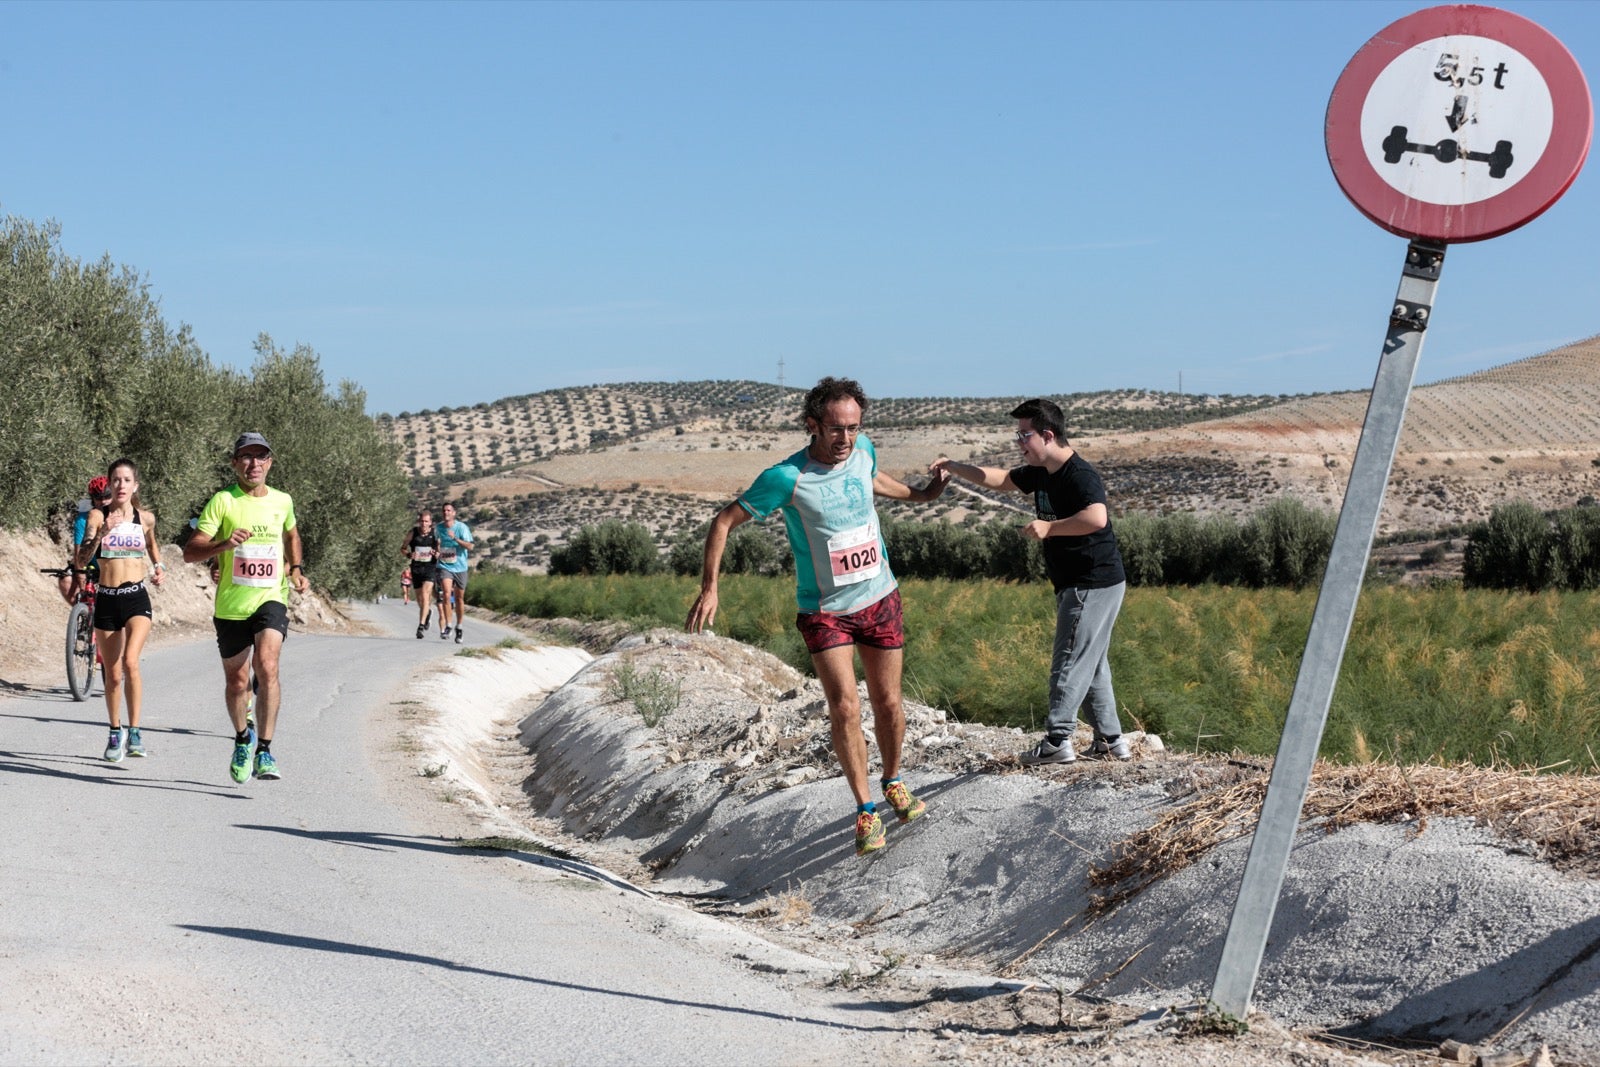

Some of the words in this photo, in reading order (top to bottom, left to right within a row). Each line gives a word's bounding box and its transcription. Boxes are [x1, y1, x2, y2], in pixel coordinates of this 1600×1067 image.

[1493, 63, 1508, 89] t
[109, 535, 141, 547] 2085
[840, 547, 877, 570] 1020
[240, 563, 273, 576] 1030
[117, 584, 139, 596] PRO
